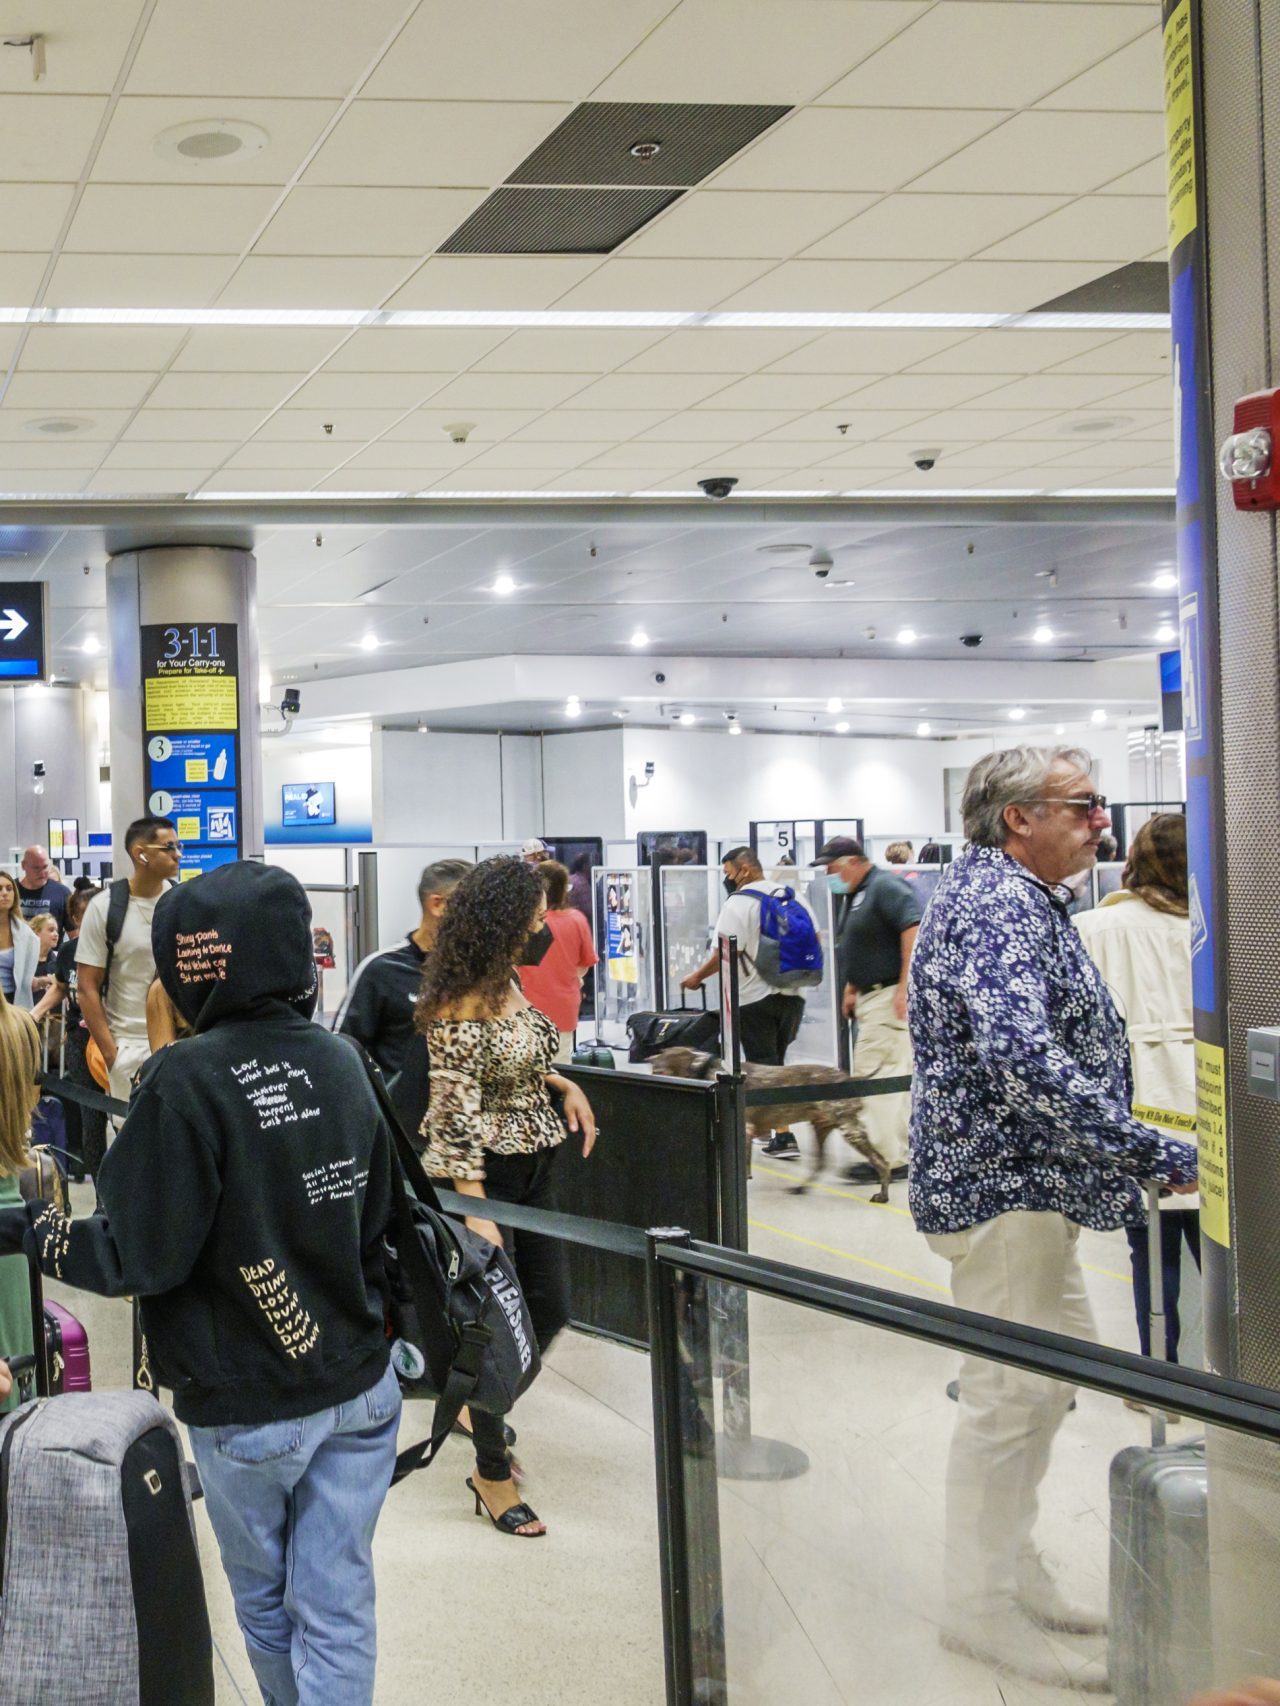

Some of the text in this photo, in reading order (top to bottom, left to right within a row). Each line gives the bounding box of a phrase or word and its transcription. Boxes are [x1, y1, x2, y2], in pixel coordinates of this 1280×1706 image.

[164, 627, 220, 658] 3-1-1
[157, 659, 226, 668] for Your Carry-ons
[158, 668, 182, 676] Prepare
[156, 740, 164, 758] 3
[158, 796, 163, 811] 1
[778, 832, 788, 846] 5
[20, 899, 50, 908] NDER
[231, 1059, 258, 1076] Love
[281, 1061, 292, 1070] it
[258, 1102, 294, 1117] happens
[240, 1258, 274, 1282] DEAD
[249, 1270, 286, 1297] DYING
[259, 1286, 288, 1310] LOST
[280, 1310, 310, 1346] DOWN
[286, 1322, 320, 1358] TOWN
